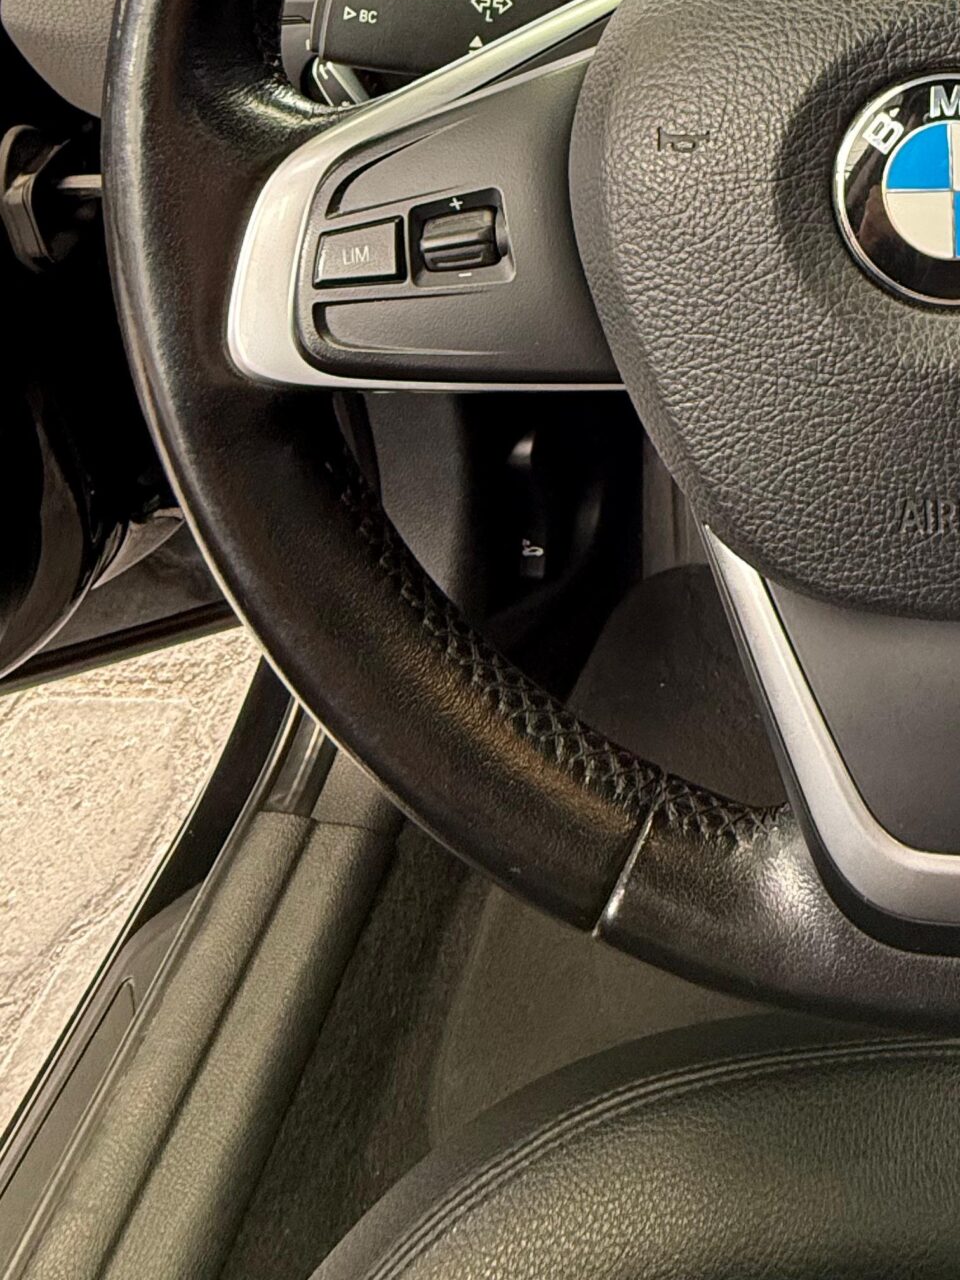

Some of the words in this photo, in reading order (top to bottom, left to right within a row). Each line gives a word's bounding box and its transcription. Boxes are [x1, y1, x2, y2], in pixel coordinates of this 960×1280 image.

[359, 9, 378, 24] BC
[485, 10, 493, 22] L
[342, 245, 370, 266] LIM
